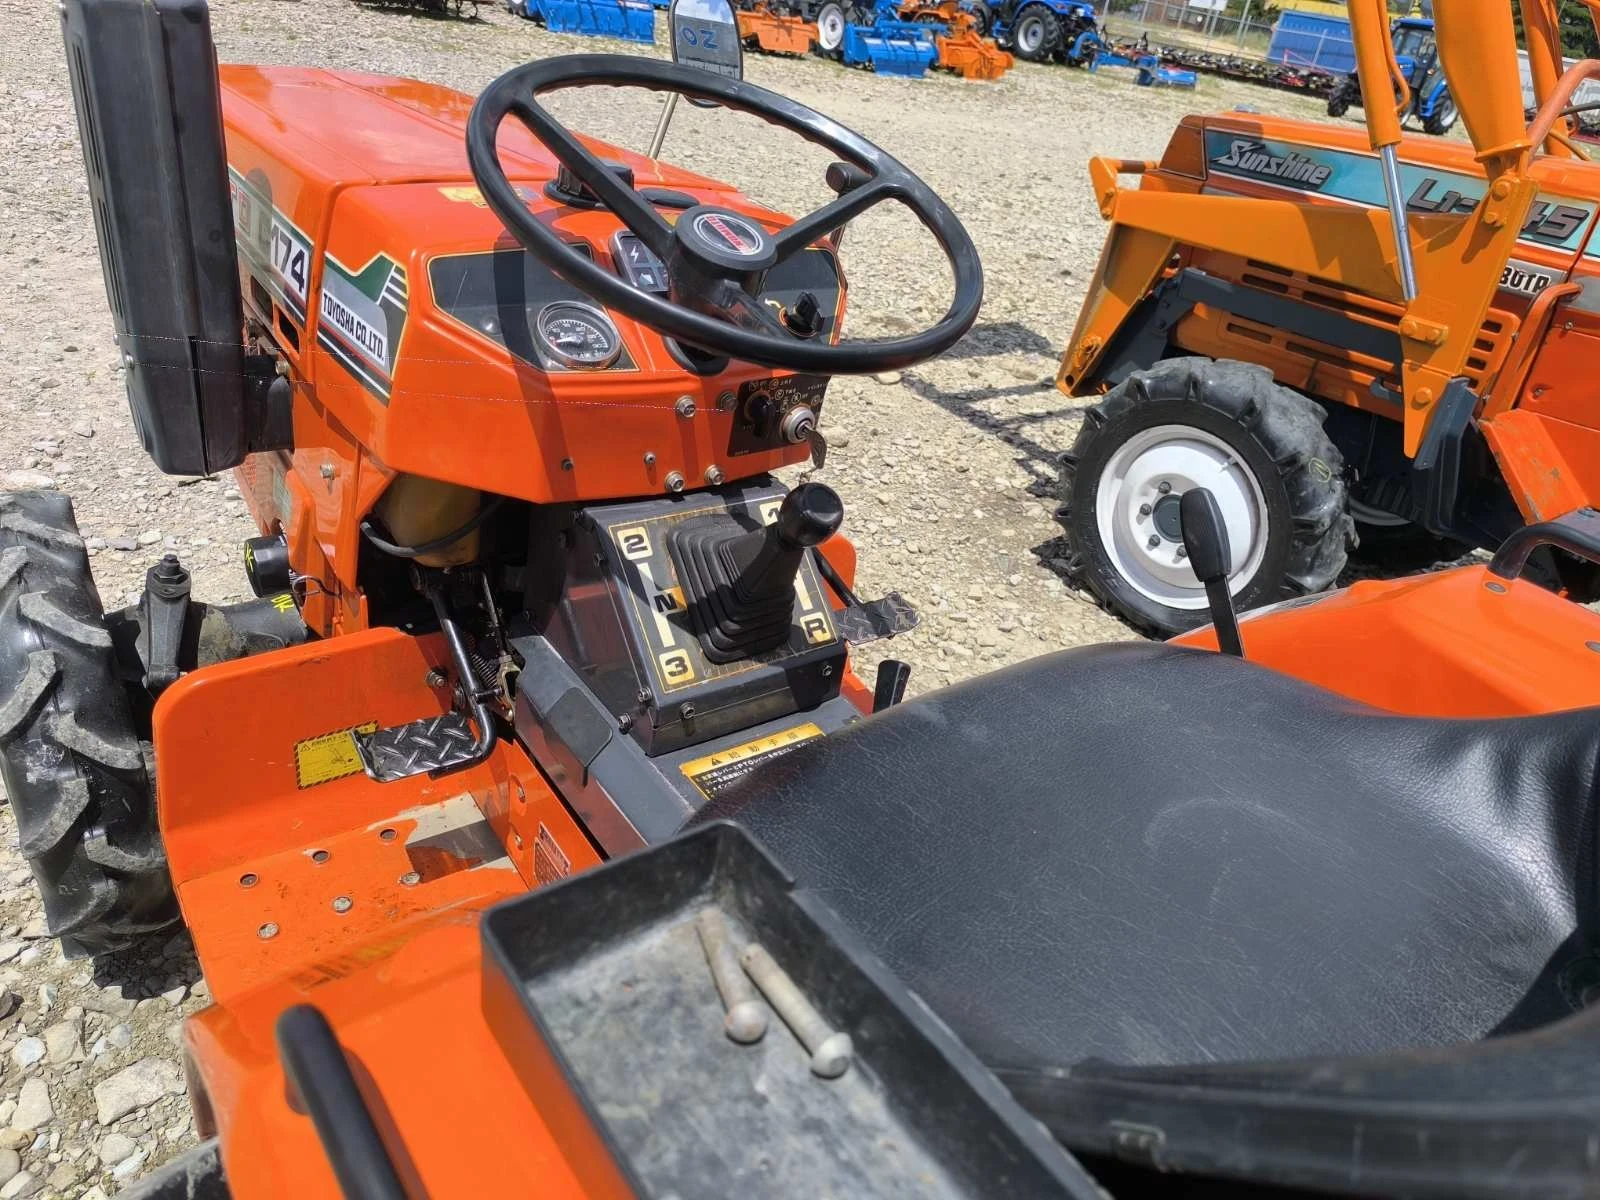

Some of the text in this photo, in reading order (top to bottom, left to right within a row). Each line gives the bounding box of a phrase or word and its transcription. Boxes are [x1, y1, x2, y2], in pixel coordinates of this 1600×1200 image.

[1215, 139, 1332, 186] Sunshine
[1499, 266, 1551, 294] BOTA
[323, 292, 355, 337] TOYOSHA
[623, 533, 648, 554] 2
[654, 593, 677, 612] N
[804, 617, 827, 639] R
[665, 656, 689, 678] 3
